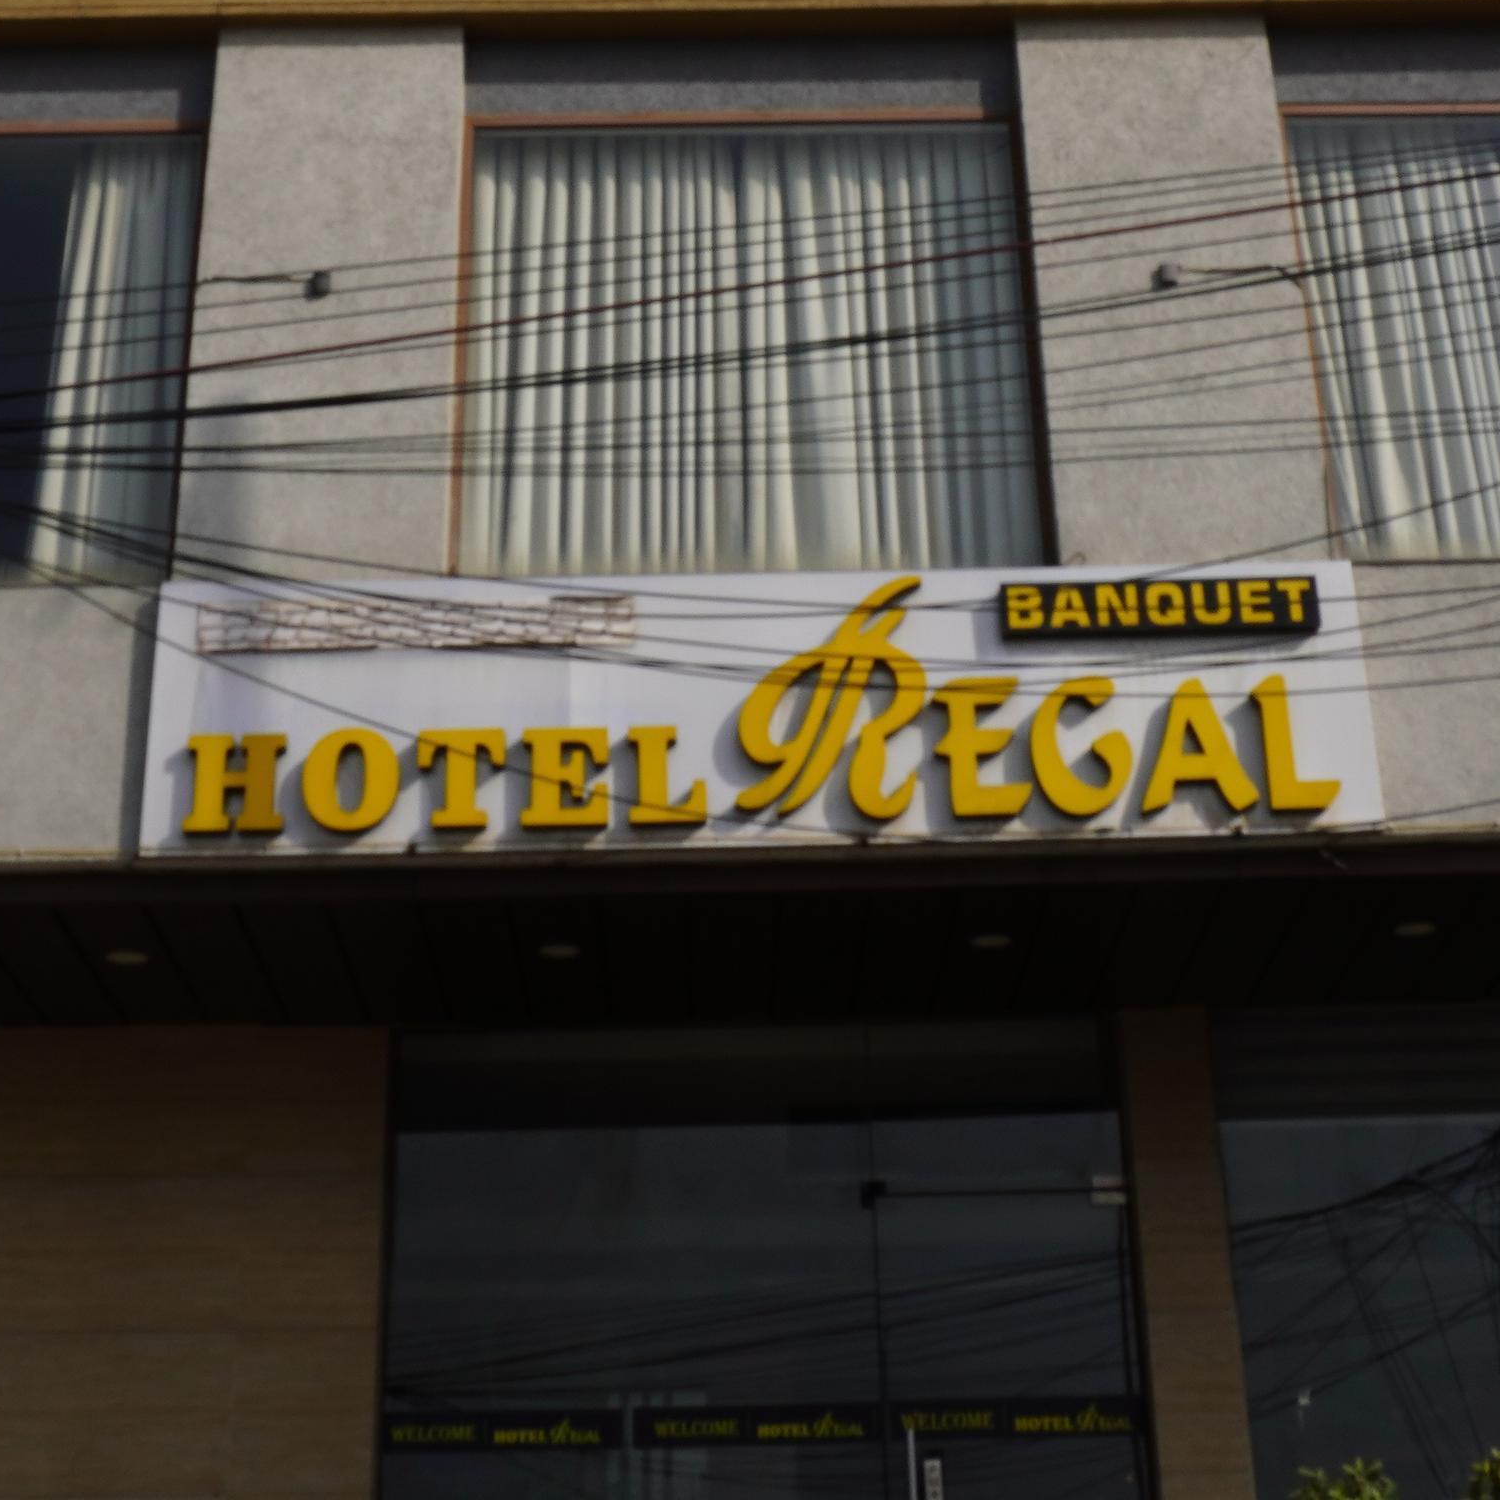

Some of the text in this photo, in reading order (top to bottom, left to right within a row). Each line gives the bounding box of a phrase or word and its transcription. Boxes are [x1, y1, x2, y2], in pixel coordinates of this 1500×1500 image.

[1007, 579, 1310, 631] BANQUET
[182, 575, 1341, 833] HOTEL REGAL
[654, 1419, 740, 1438] WELCOME
[902, 1411, 993, 1430] WELCOME
[391, 1423, 476, 1443] WELCOME
